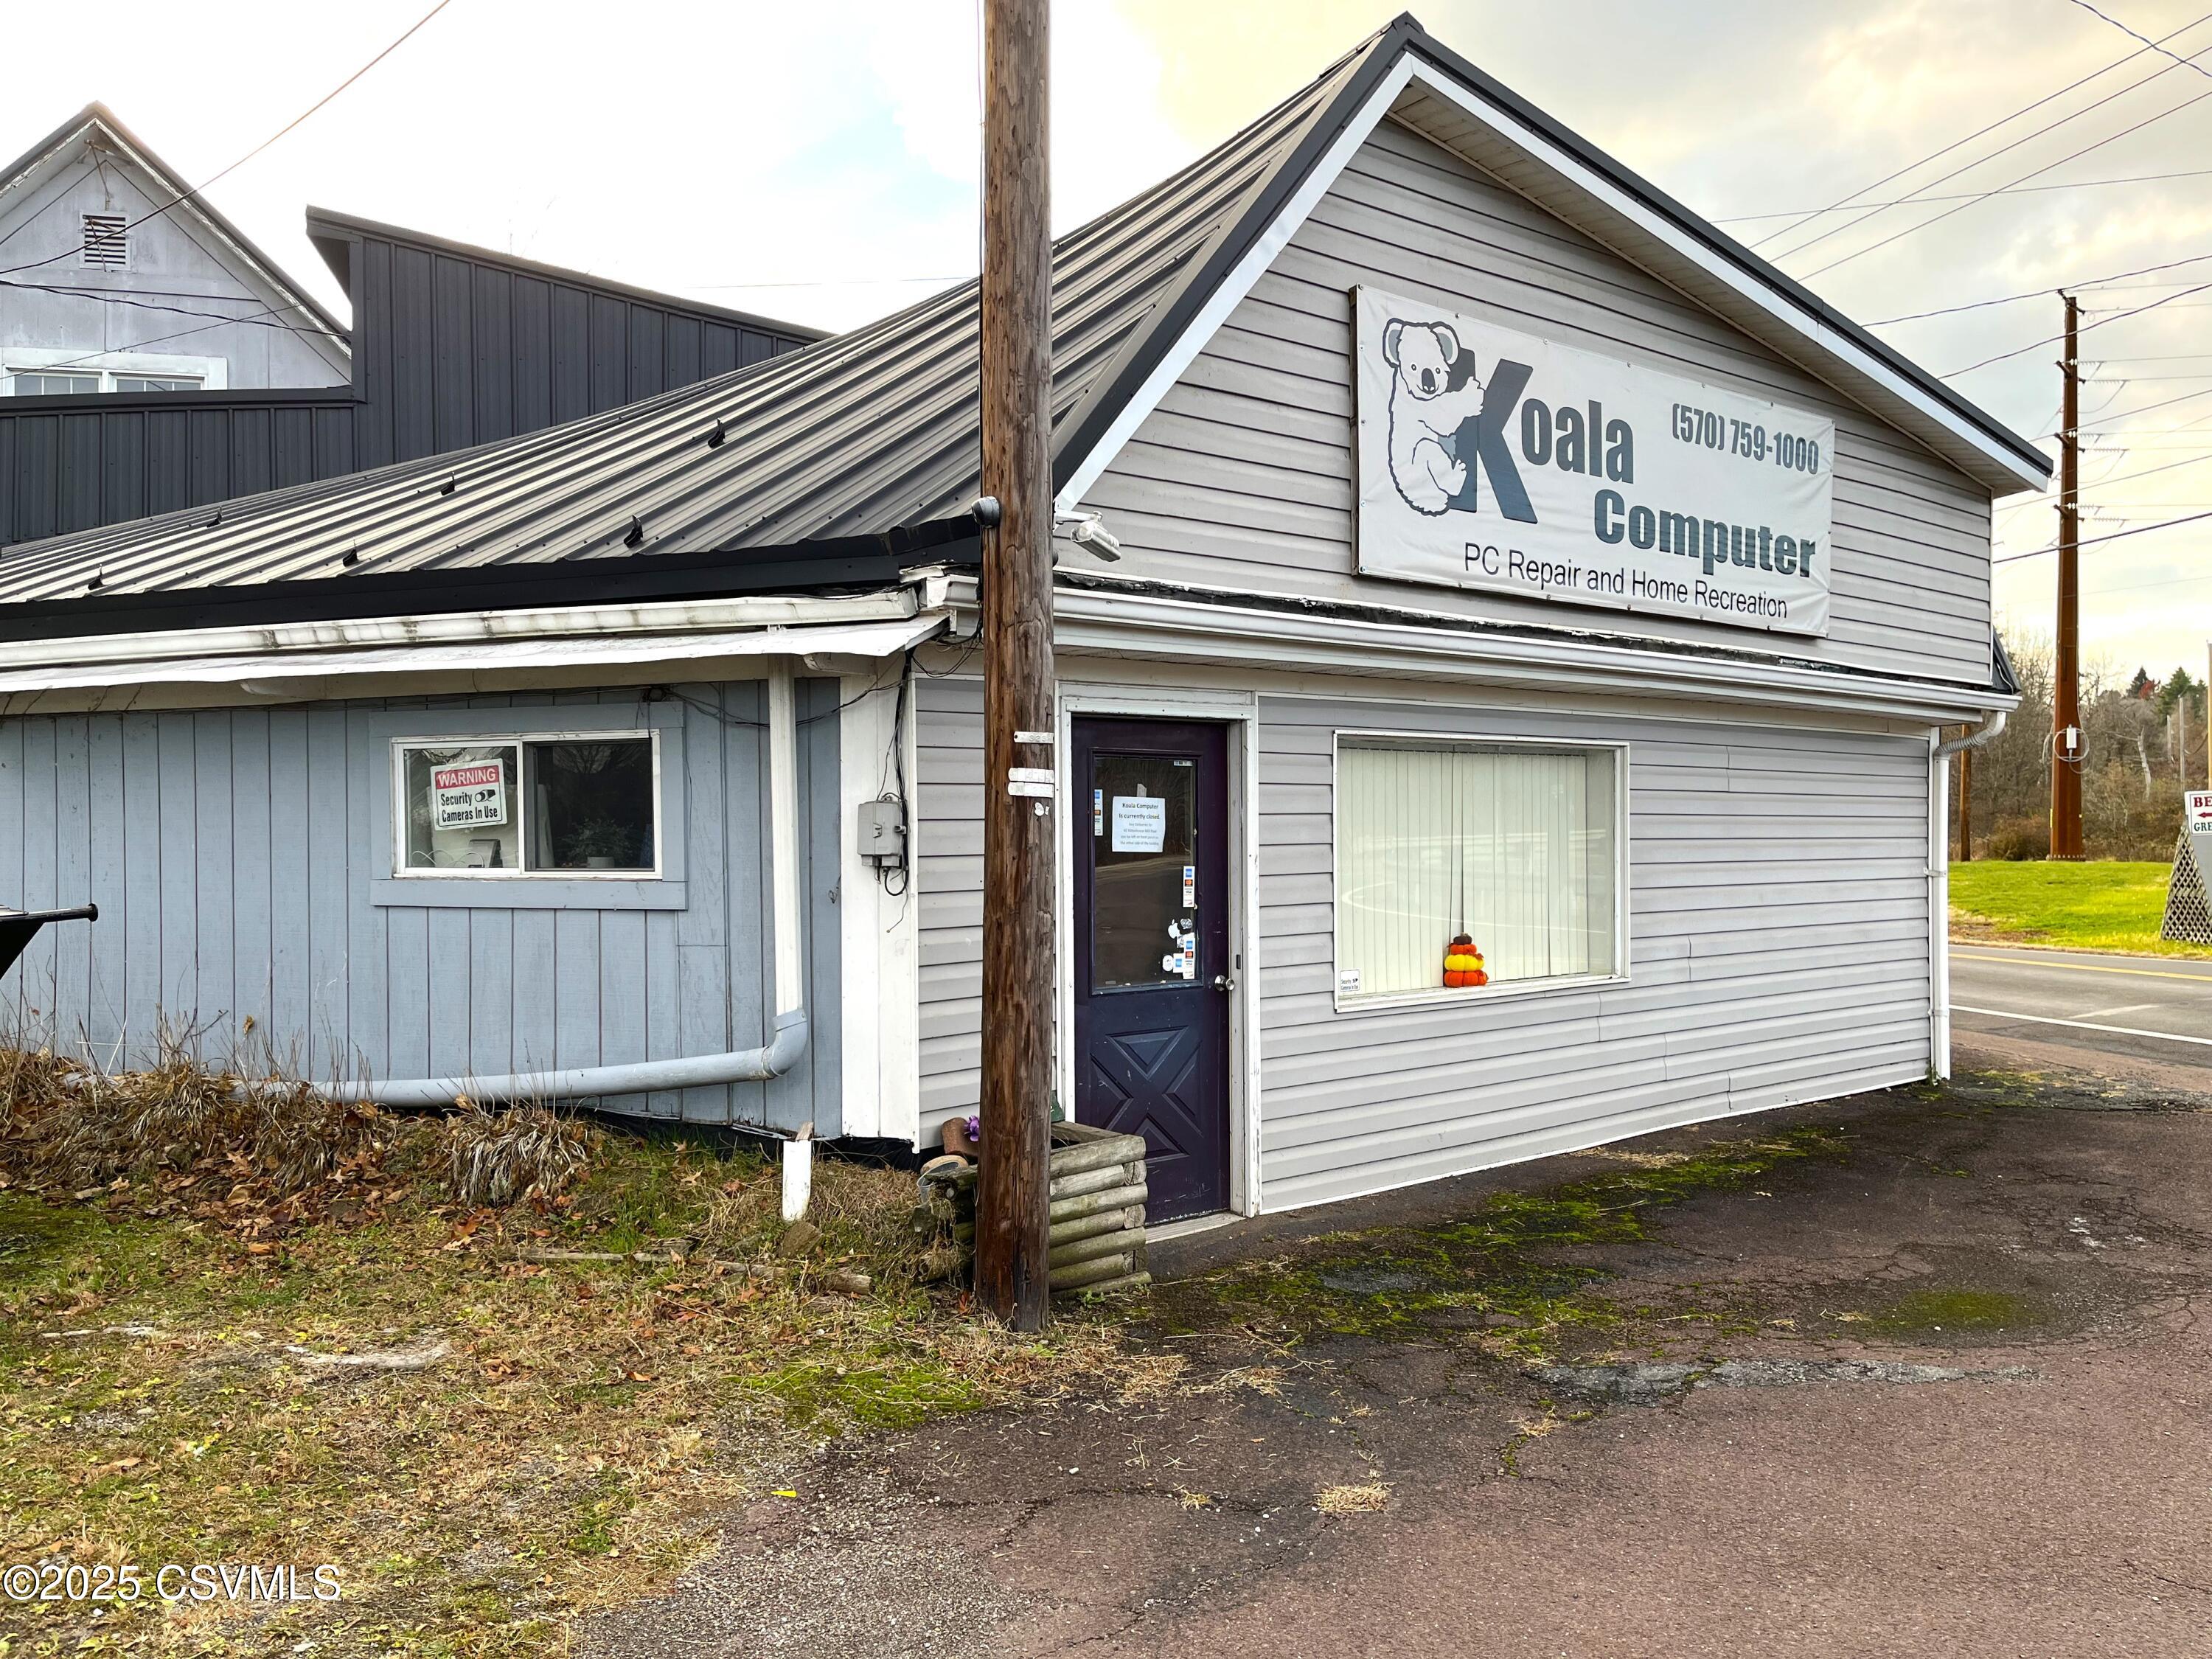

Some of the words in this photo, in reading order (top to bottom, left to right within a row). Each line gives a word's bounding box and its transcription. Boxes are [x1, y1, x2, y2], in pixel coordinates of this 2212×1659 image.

[1447, 347, 1635, 524] Koala
[1672, 403, 1725, 451] (570)
[1731, 418, 1820, 475] 759-1000
[1593, 489, 1817, 577] Computer
[1464, 542, 1500, 575] PC
[1509, 551, 1581, 589] Repair
[1587, 567, 1625, 594] and
[1632, 569, 1688, 604] Home
[1695, 580, 1788, 619] Recreation
[437, 768, 495, 787] WARNING
[440, 791, 473, 806] Security
[442, 809, 473, 822] Cameras
[475, 806, 482, 819] In
[484, 805, 498, 818] Use
